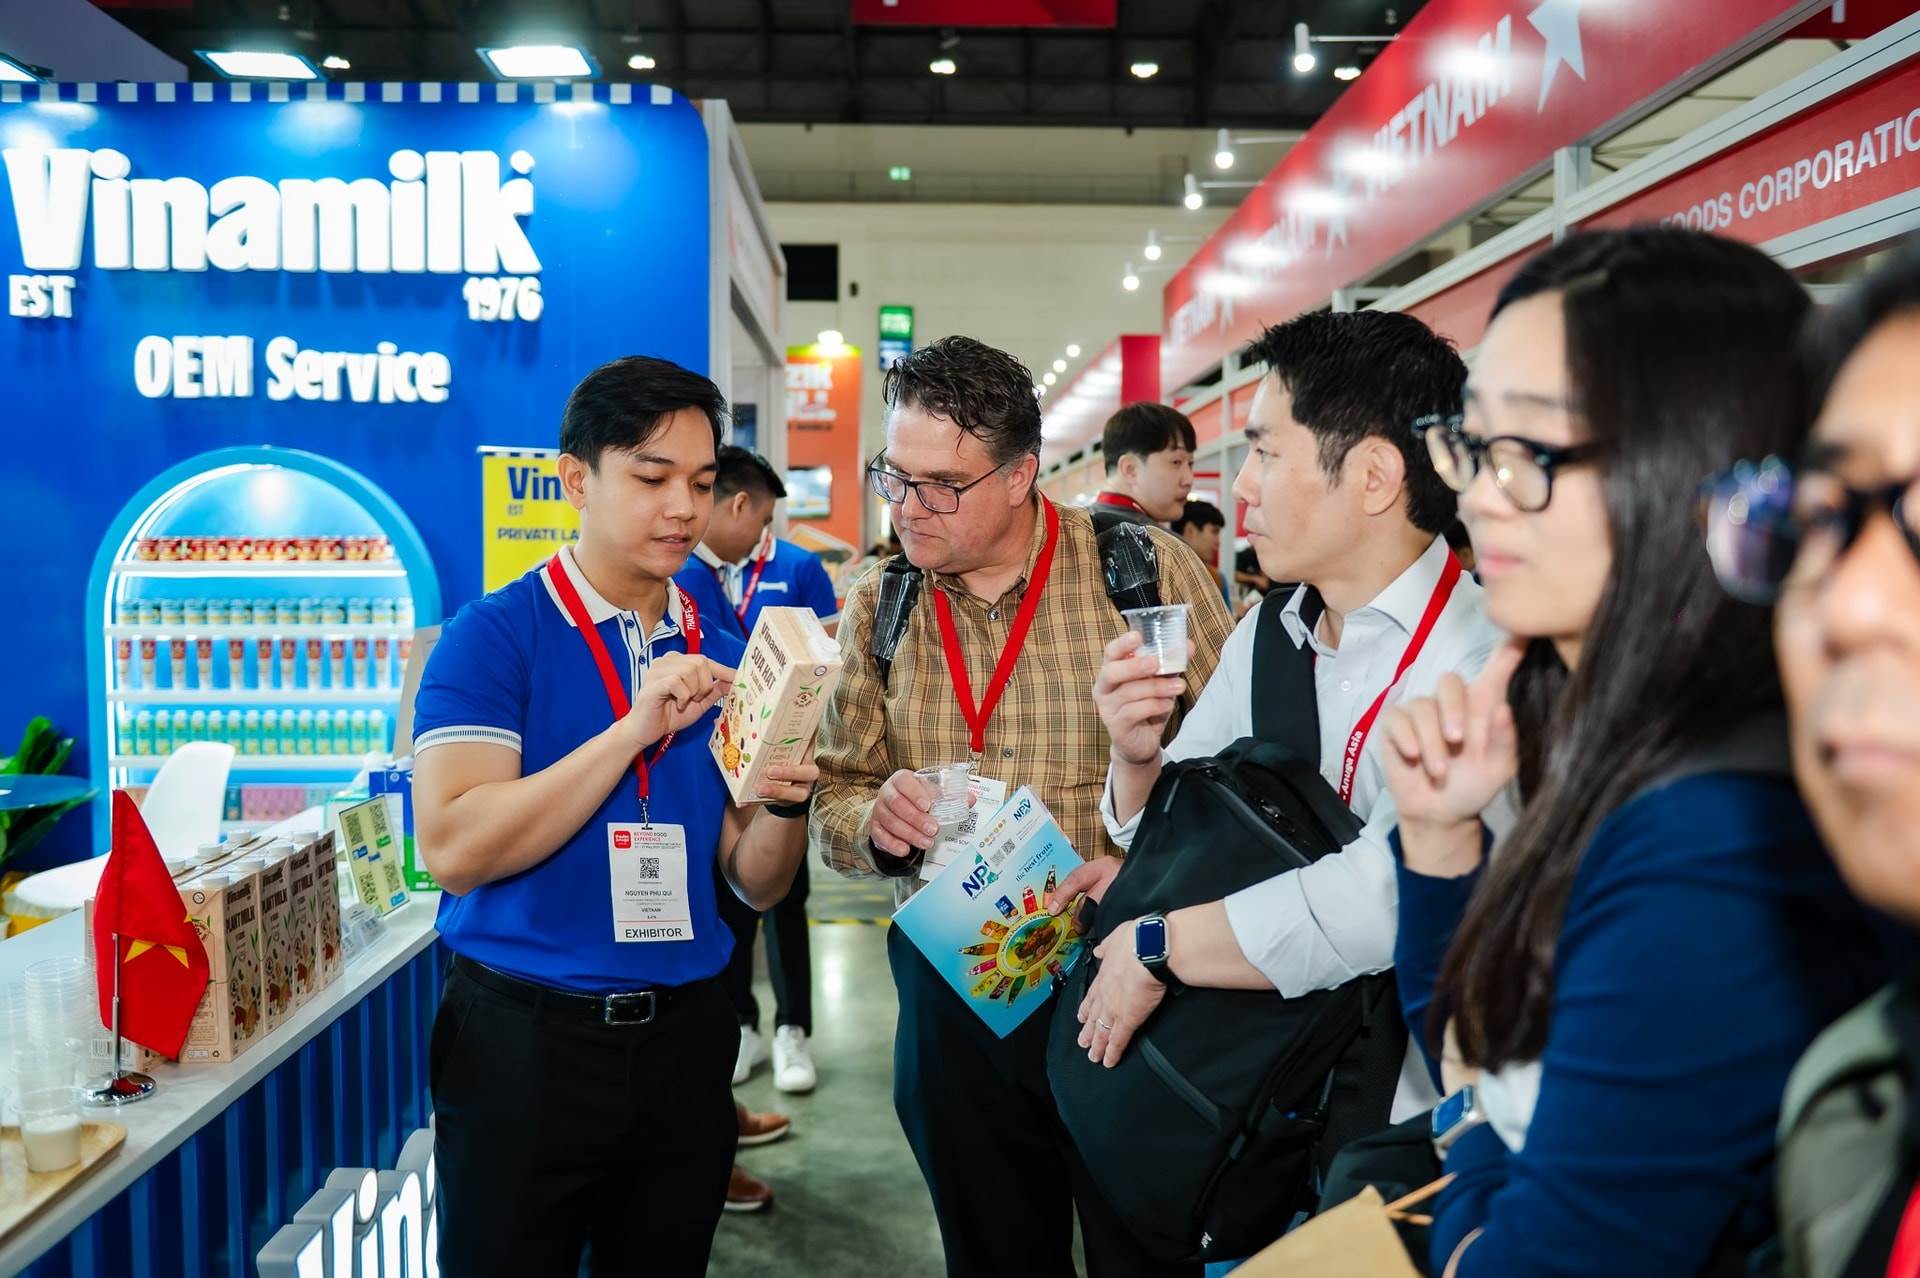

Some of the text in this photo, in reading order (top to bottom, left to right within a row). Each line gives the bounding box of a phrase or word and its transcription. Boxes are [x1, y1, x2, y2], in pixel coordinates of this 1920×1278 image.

[3, 149, 541, 273] Vinamilk
[9, 275, 543, 321] EST 1976
[134, 336, 451, 403] OEM Service
[497, 528, 556, 541] PRIVATE
[761, 621, 787, 668] Vinamilk
[1347, 730, 1364, 757] Asia
[962, 861, 990, 897] NP
[625, 928, 683, 938] EXHIBITOR
